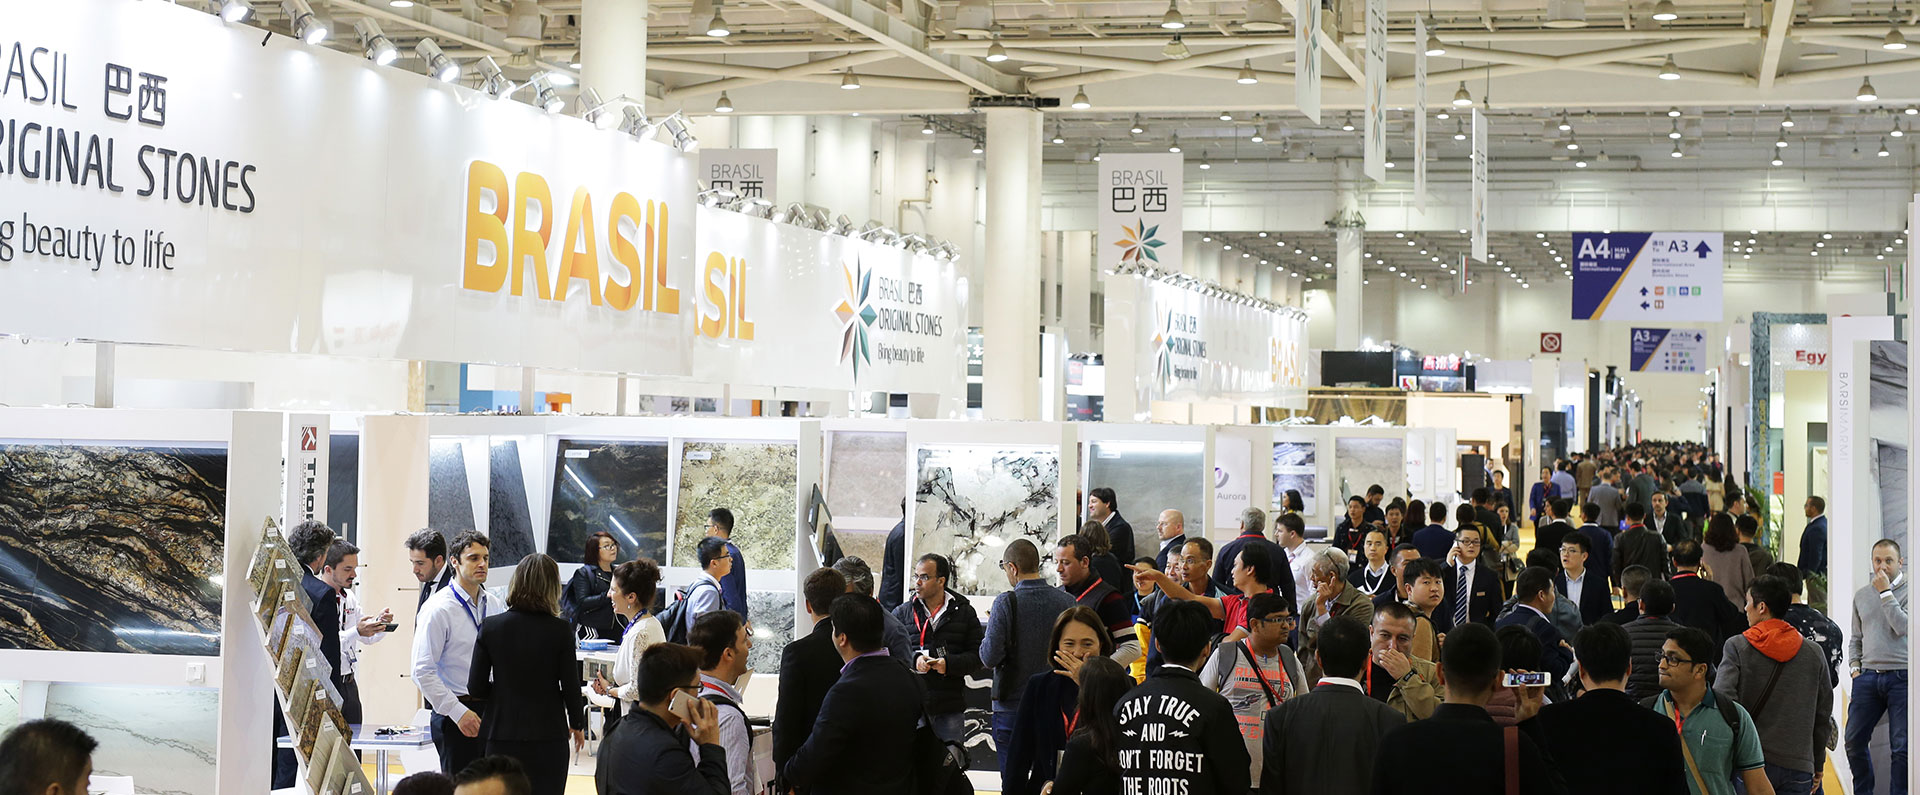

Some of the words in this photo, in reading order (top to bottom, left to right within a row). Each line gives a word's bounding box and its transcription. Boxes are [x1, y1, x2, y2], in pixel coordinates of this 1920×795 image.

[0, 40, 77, 110] ASIL
[105, 62, 168, 127] 巴西
[0, 118, 123, 192] IGINAL
[136, 144, 256, 214] STONES
[711, 163, 764, 179] BRASIL
[1112, 169, 1168, 186] BRASIL
[1112, 187, 1168, 213] 巴西
[22, 212, 106, 272] beauty
[112, 229, 135, 265] to
[144, 229, 175, 270] life
[461, 160, 680, 314] BRASIL
[1578, 238, 1610, 259] A4
[1668, 239, 1689, 252] A3
[694, 251, 754, 341] SIL
[879, 277, 904, 303] BRASIL
[878, 308, 913, 333] ORIGINAL
[915, 313, 942, 337] STONES
[1633, 330, 1650, 342] A3
[1796, 350, 1827, 365] Egy
[1217, 492, 1246, 500] Aurora
[1119, 695, 1152, 725] STAY
[1158, 694, 1200, 728] TRUE
[1141, 723, 1166, 742] AND
[1119, 749, 1141, 769] ON'T
[1149, 749, 1204, 773] FORGET
[1122, 776, 1142, 795] THE
[1148, 777, 1189, 795] ROOTS
